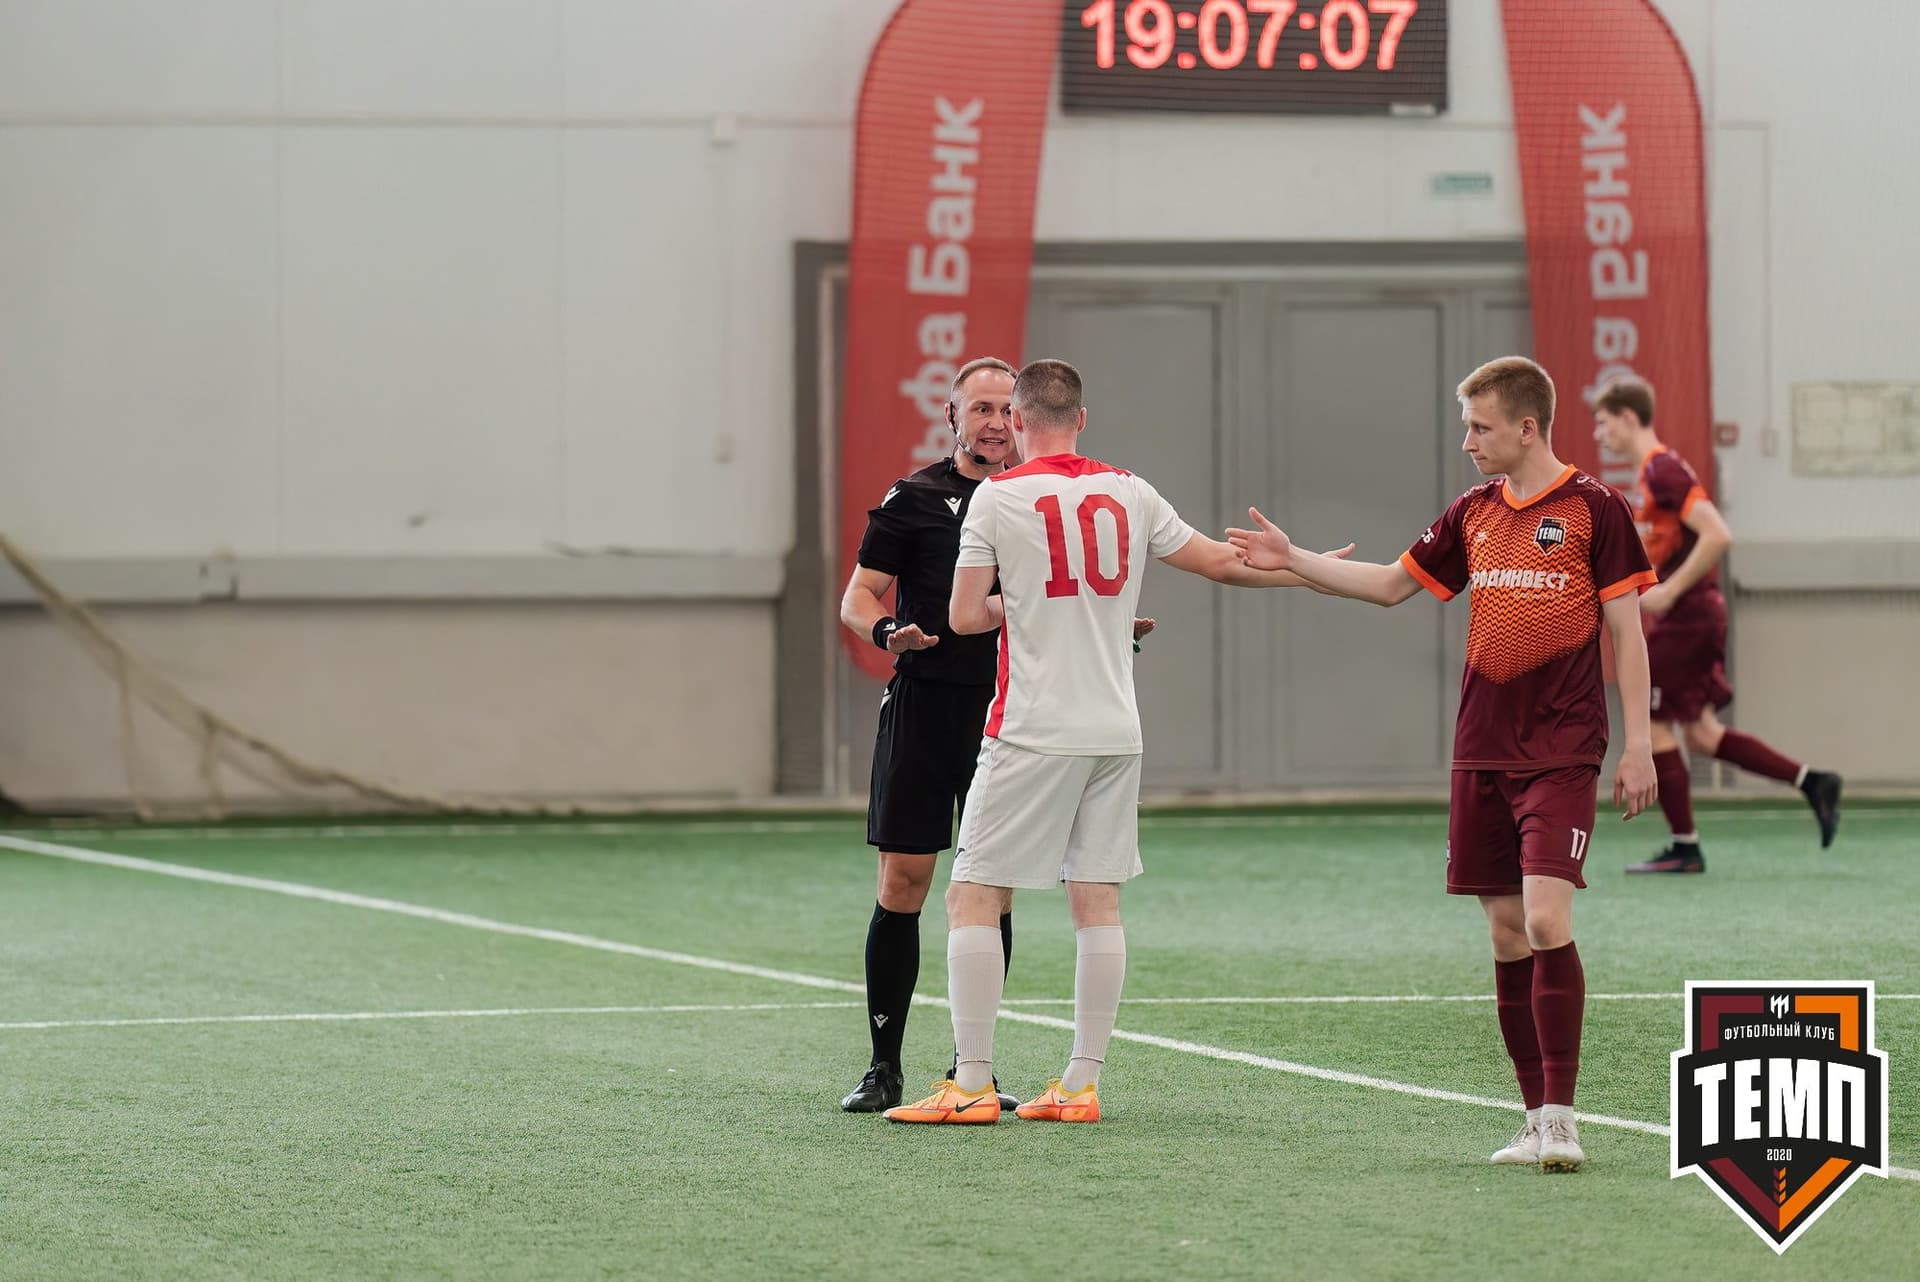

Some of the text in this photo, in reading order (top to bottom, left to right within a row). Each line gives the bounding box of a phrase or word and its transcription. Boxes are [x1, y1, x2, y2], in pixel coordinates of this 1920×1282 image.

[1081, 0, 1418, 70] 19:07:07
[899, 96, 985, 476] ьфа Банк
[1034, 493, 1131, 598] 10
[1538, 527, 1563, 543] ТЕМП
[1471, 568, 1570, 591] РОДИНВЕСТ
[1570, 827, 1587, 861] 17
